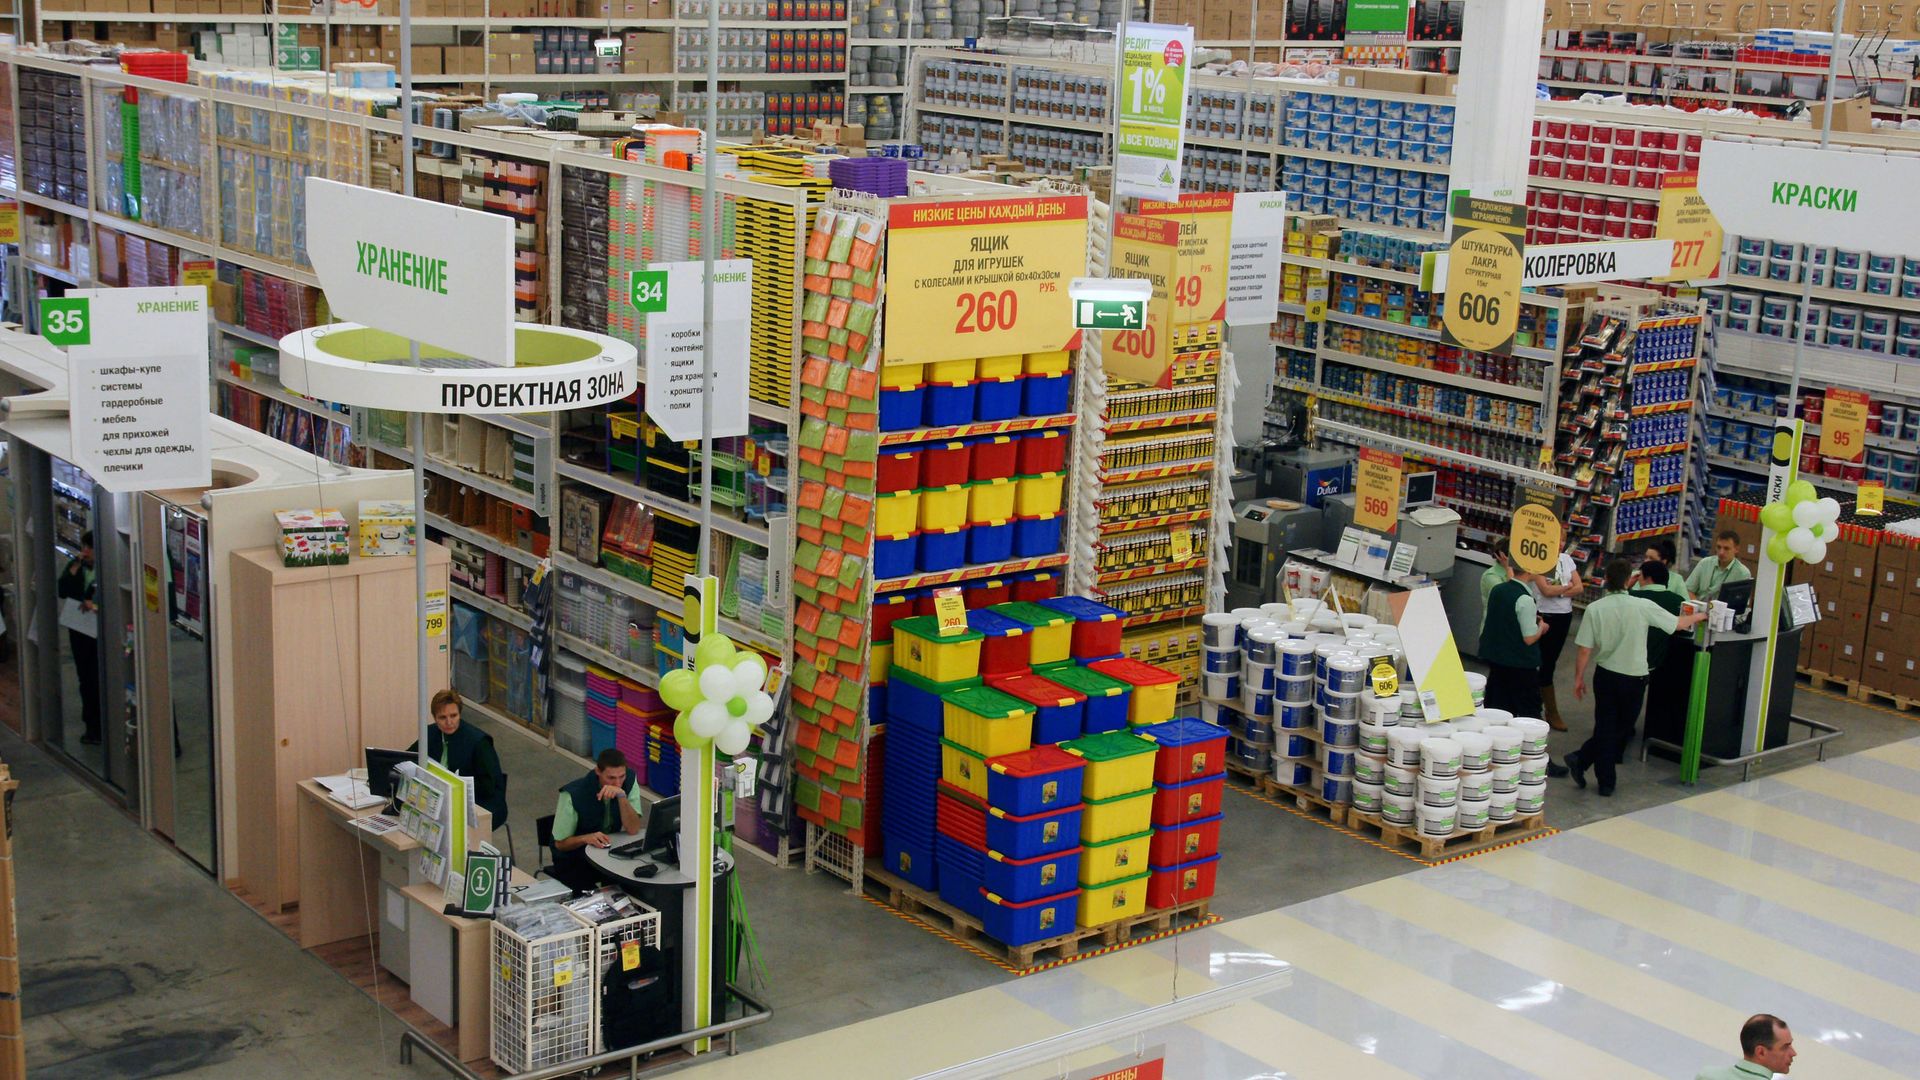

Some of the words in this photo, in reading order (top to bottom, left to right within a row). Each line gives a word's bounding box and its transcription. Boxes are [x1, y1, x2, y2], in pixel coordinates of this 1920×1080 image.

[1125, 37, 1151, 51] РЕДИТ
[1129, 66, 1166, 114] 1%
[1126, 134, 1143, 146] ВСЕ
[1144, 136, 1177, 150] ТОВАРЫ!
[1771, 181, 1858, 212] КРАСКИ
[1142, 201, 1167, 210] НИЗКИЕ
[1185, 199, 1213, 209] КАЖДЫЙ
[1259, 200, 1282, 209] КРАСКИ
[1470, 201, 1513, 215] ПРЕДЛОЖЕНИЕ
[913, 208, 954, 223] НИЗКИЕ
[956, 206, 986, 221] ЦЕНЫ
[989, 204, 1034, 220] КАЖДЫЙ
[1036, 202, 1066, 218] ДЕНЬ!
[1471, 213, 1511, 224] ОГРАНИЧЕНО!
[1178, 221, 1197, 236] ЛЕЙ
[970, 235, 1009, 253] ЯЩИК
[1183, 238, 1209, 248] МОНТАЖ
[1461, 240, 1513, 257] ШТУКАТУРКА
[1125, 252, 1150, 267] ЯЩИК
[1671, 239, 1704, 268] 277
[356, 240, 448, 295] ХРАНЕНИЕ
[953, 258, 975, 274] ДЛЯ
[977, 255, 1024, 271] ИГРУШЕК
[1471, 256, 1497, 269] ЛАКРА
[1524, 251, 1616, 279] КОЛЕРОВКА
[914, 279, 920, 289] С
[921, 276, 965, 288] КОЛЕСАМИ
[966, 275, 973, 285] И
[974, 271, 1013, 285] КРЫШКОЙ
[636, 281, 663, 303] 34
[1039, 282, 1058, 293] РУБ.
[137, 300, 199, 314] ХРАНЕНИЕ
[955, 289, 1018, 334] 260
[1458, 292, 1500, 326] 606
[47, 310, 84, 334] 35
[671, 329, 701, 340] коробки
[671, 344, 704, 353] контейне
[1112, 325, 1155, 359] 260
[100, 364, 162, 377] шкафы-купе
[670, 360, 694, 368] ящики
[670, 374, 683, 383] для
[101, 382, 143, 392] системы
[441, 379, 581, 408] ПРОЕКТНАЯ
[586, 370, 624, 400] ЗОНА
[101, 397, 163, 409] гардеробные
[669, 402, 691, 410] полки
[102, 415, 137, 425] мебель
[102, 431, 120, 442] для
[122, 428, 169, 440] прихожей
[1833, 430, 1850, 446] 95
[103, 447, 132, 457] чехлы
[134, 446, 153, 456] для
[154, 444, 195, 455] одежды,
[103, 462, 144, 473] плечики
[1316, 484, 1338, 496] Dulux
[1364, 496, 1389, 517] 569
[1521, 508, 1555, 522] ШТУКАТУРКА
[1520, 538, 1548, 561] 606
[944, 617, 960, 627] 260
[1379, 680, 1393, 691] 606
